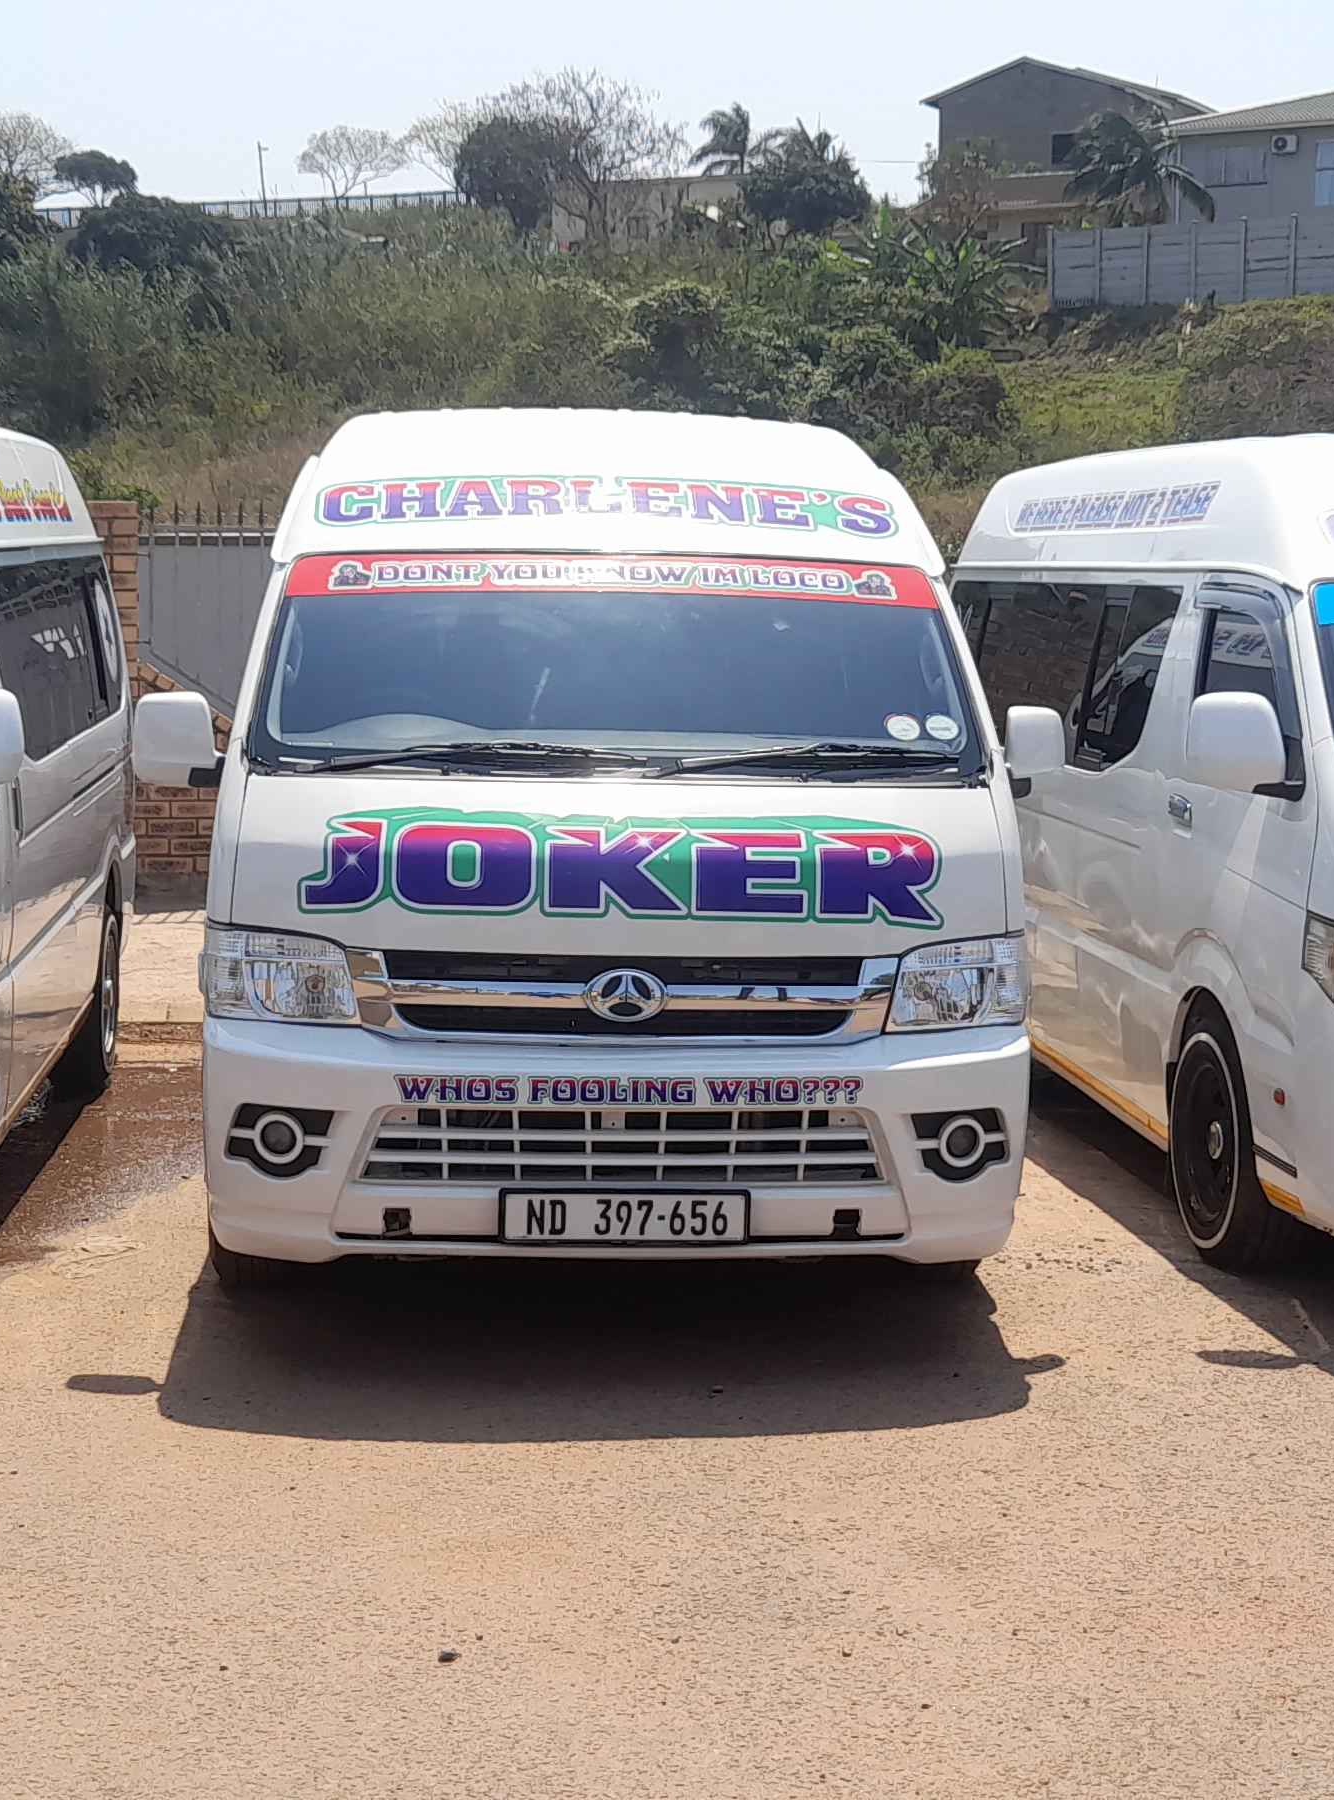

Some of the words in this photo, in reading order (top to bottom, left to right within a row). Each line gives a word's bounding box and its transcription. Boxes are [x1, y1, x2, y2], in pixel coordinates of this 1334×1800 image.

[316, 476, 898, 539] CHARLENE'S
[1068, 492, 1125, 528] PLEASE
[1115, 488, 1158, 527] NOT
[1160, 481, 1221, 524] TEASE
[375, 562, 481, 583] DONT
[489, 562, 563, 583] YOU
[698, 564, 742, 587] IM
[751, 566, 847, 591] LOCO
[299, 808, 945, 930] JOKER
[394, 1074, 518, 1104] WHOS
[528, 1075, 696, 1105] FOOLING
[704, 1076, 864, 1105] WHO???
[526, 1199, 567, 1236] ND
[593, 1198, 728, 1236] 397-656
